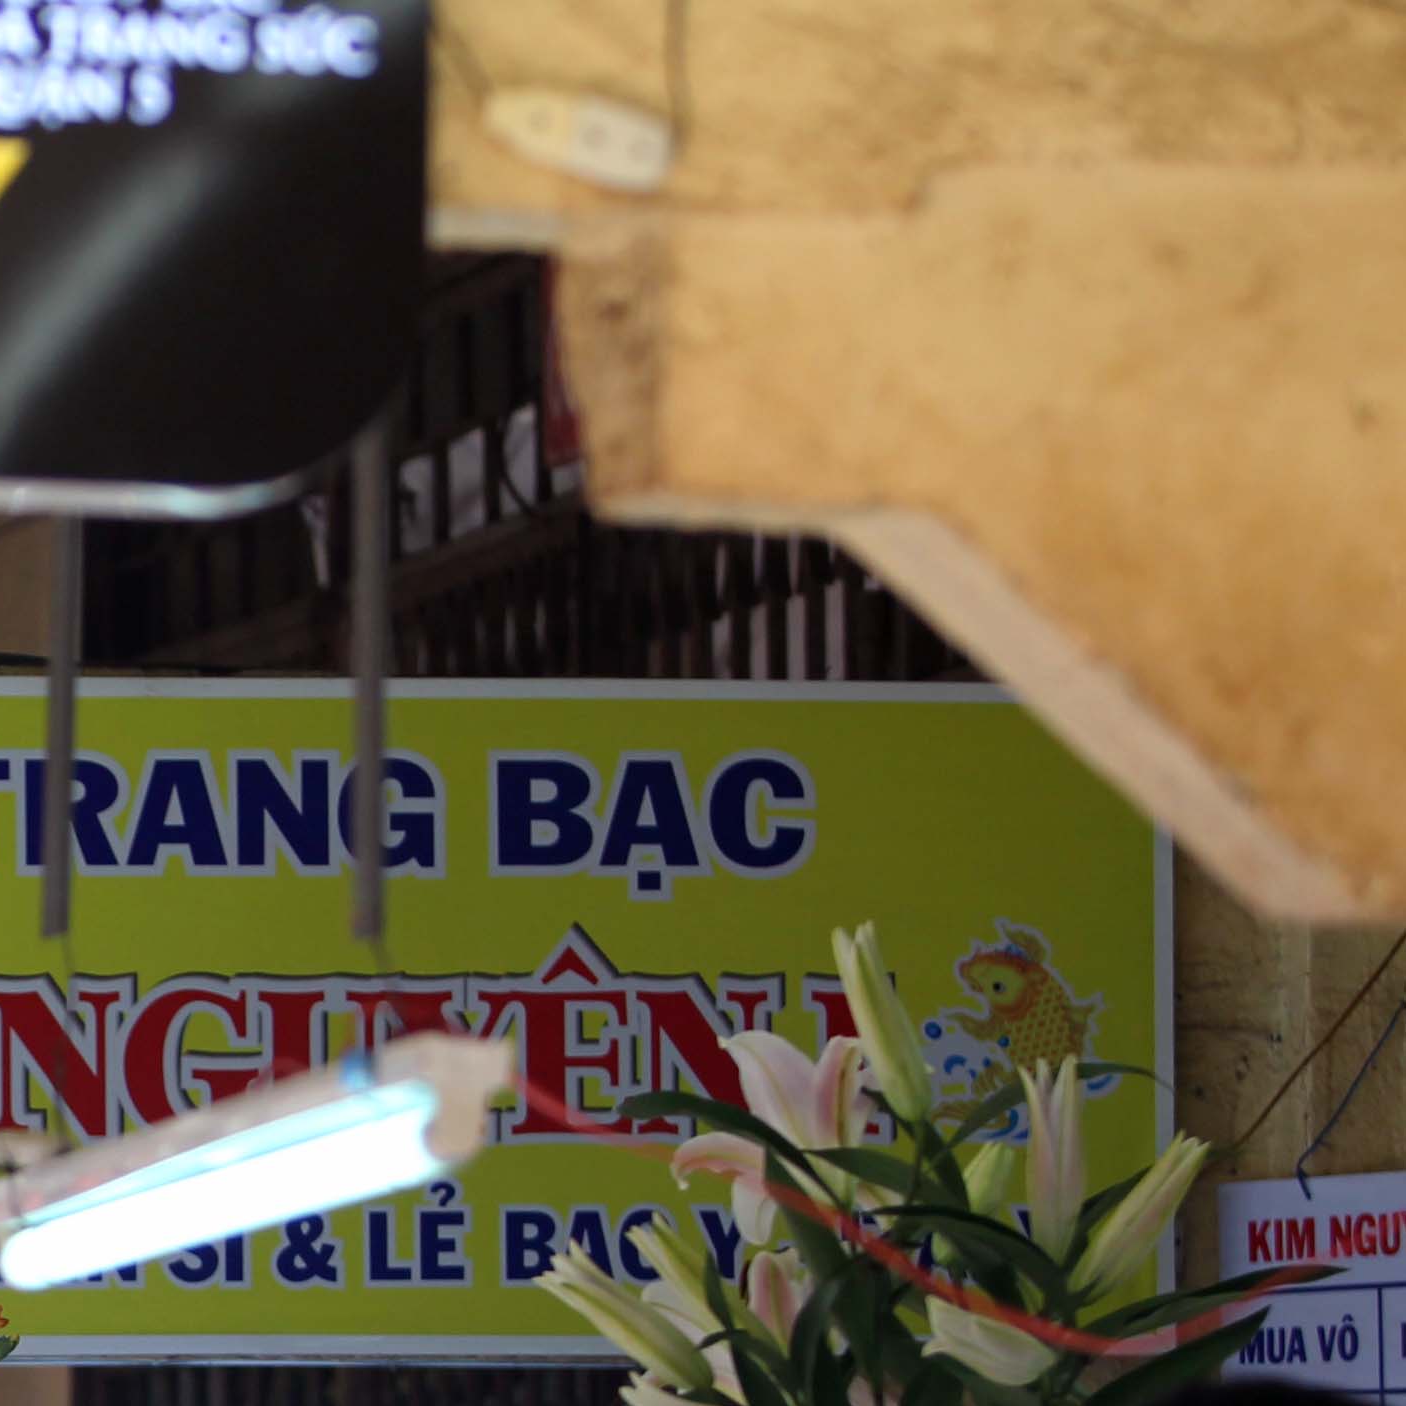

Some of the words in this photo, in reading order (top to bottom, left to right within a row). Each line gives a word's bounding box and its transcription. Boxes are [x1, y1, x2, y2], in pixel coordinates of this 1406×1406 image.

[498, 757, 807, 893] BẠC
[369, 1180, 465, 1282] LẺ
[1247, 1216, 1316, 1263] KIM
[1239, 1326, 1307, 1365] MUA
[1316, 1313, 1359, 1362] VÔ
